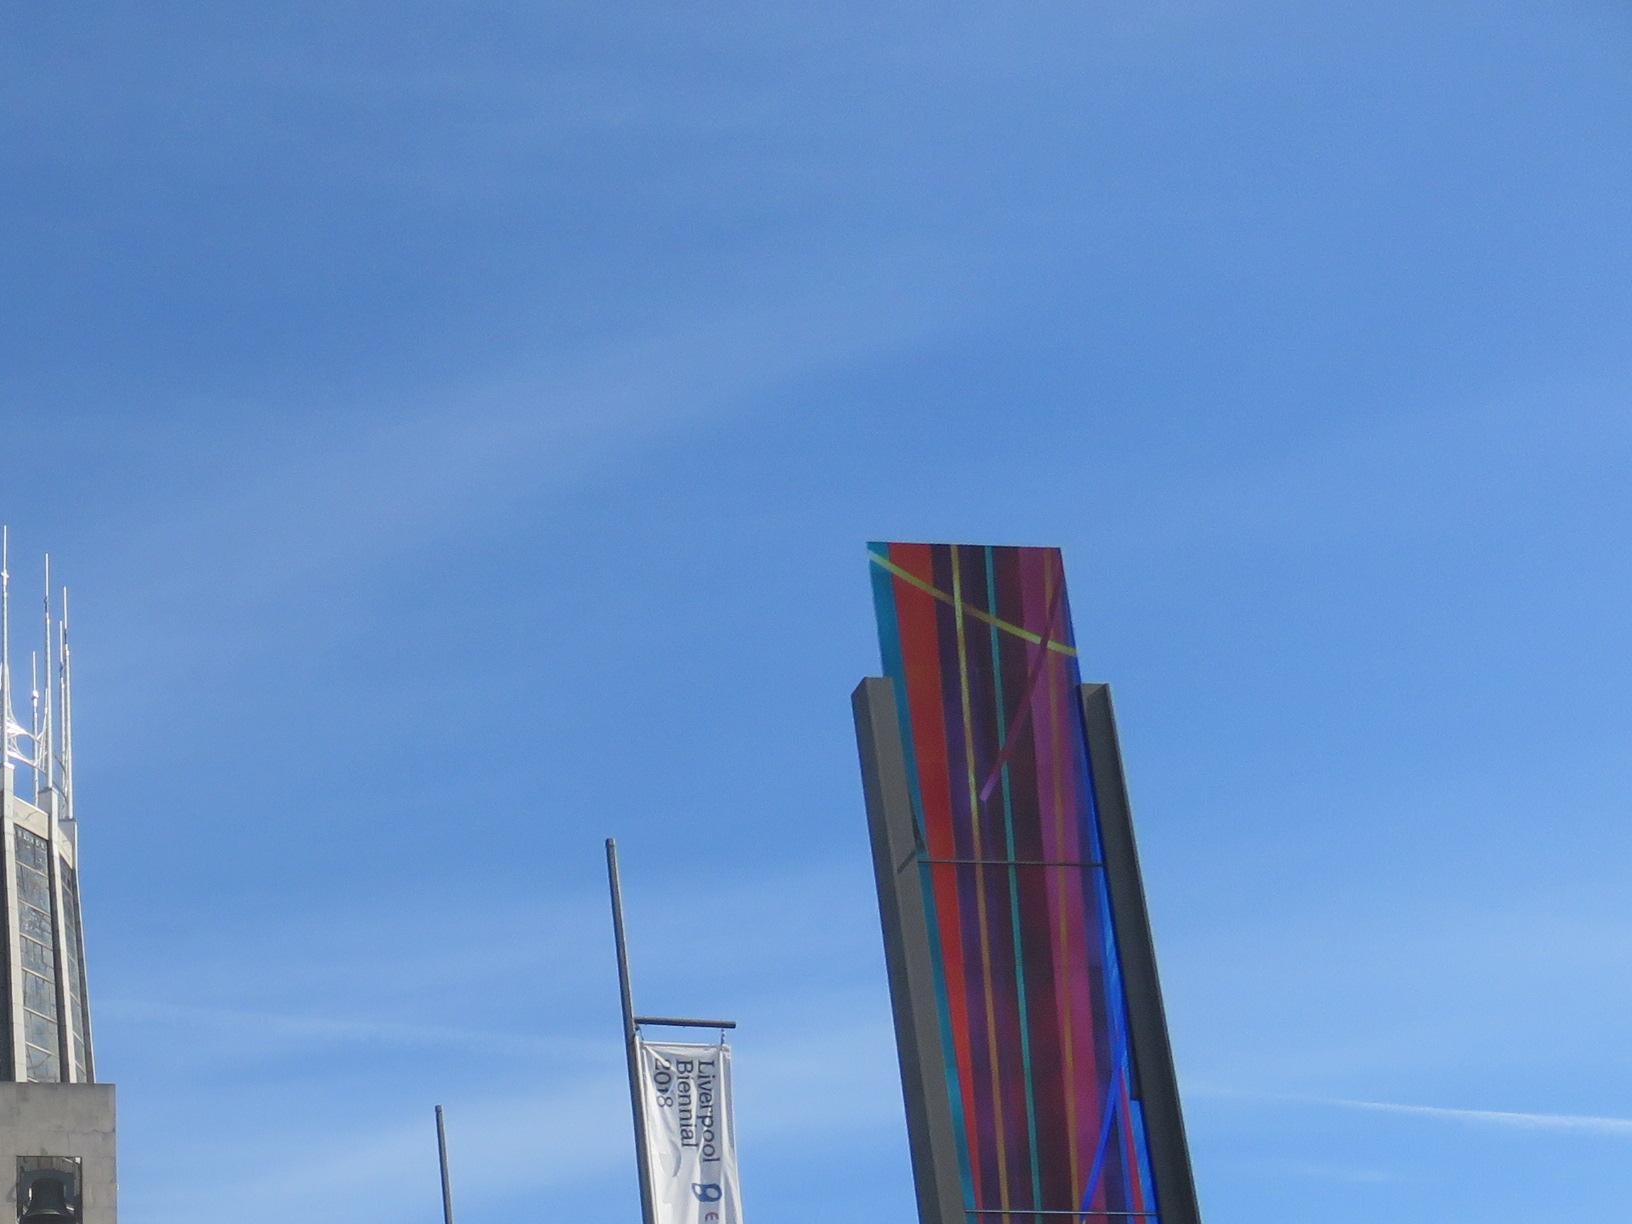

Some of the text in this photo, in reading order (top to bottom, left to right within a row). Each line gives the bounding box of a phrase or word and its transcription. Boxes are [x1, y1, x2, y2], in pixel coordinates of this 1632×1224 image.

[653, 1059, 674, 1108] 2018
[675, 1060, 699, 1147] Biennial
[696, 1060, 721, 1162] Liverpool
